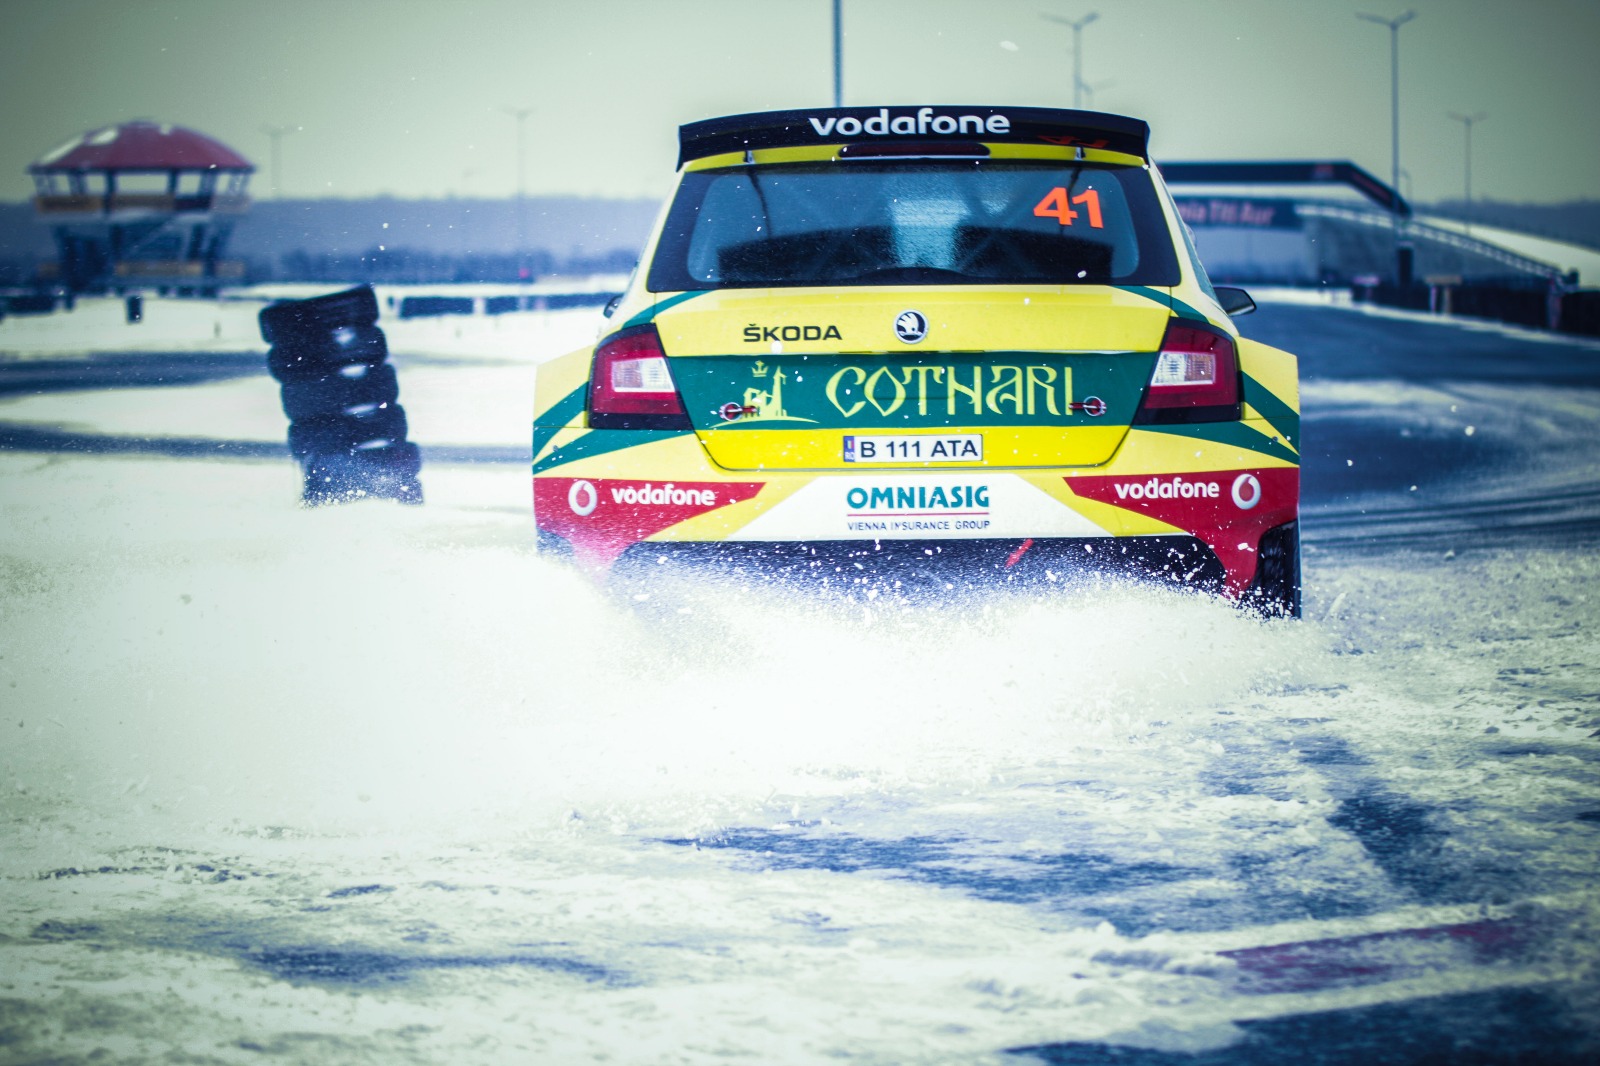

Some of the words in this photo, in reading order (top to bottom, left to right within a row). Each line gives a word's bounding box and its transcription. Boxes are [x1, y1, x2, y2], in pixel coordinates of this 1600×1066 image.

[809, 108, 1010, 136] vodafone
[1033, 187, 1103, 228] 41
[743, 323, 843, 343] ŠKODA
[860, 441, 876, 458] B
[886, 440, 921, 458] 111
[930, 439, 979, 457] ATA
[610, 484, 716, 506] vodafone
[846, 485, 990, 509] OMNIASIG
[1114, 477, 1220, 500] vodafone
[847, 521, 888, 531] VIENNA
[890, 521, 950, 531] INSURANCE
[954, 520, 991, 530] GROUP
